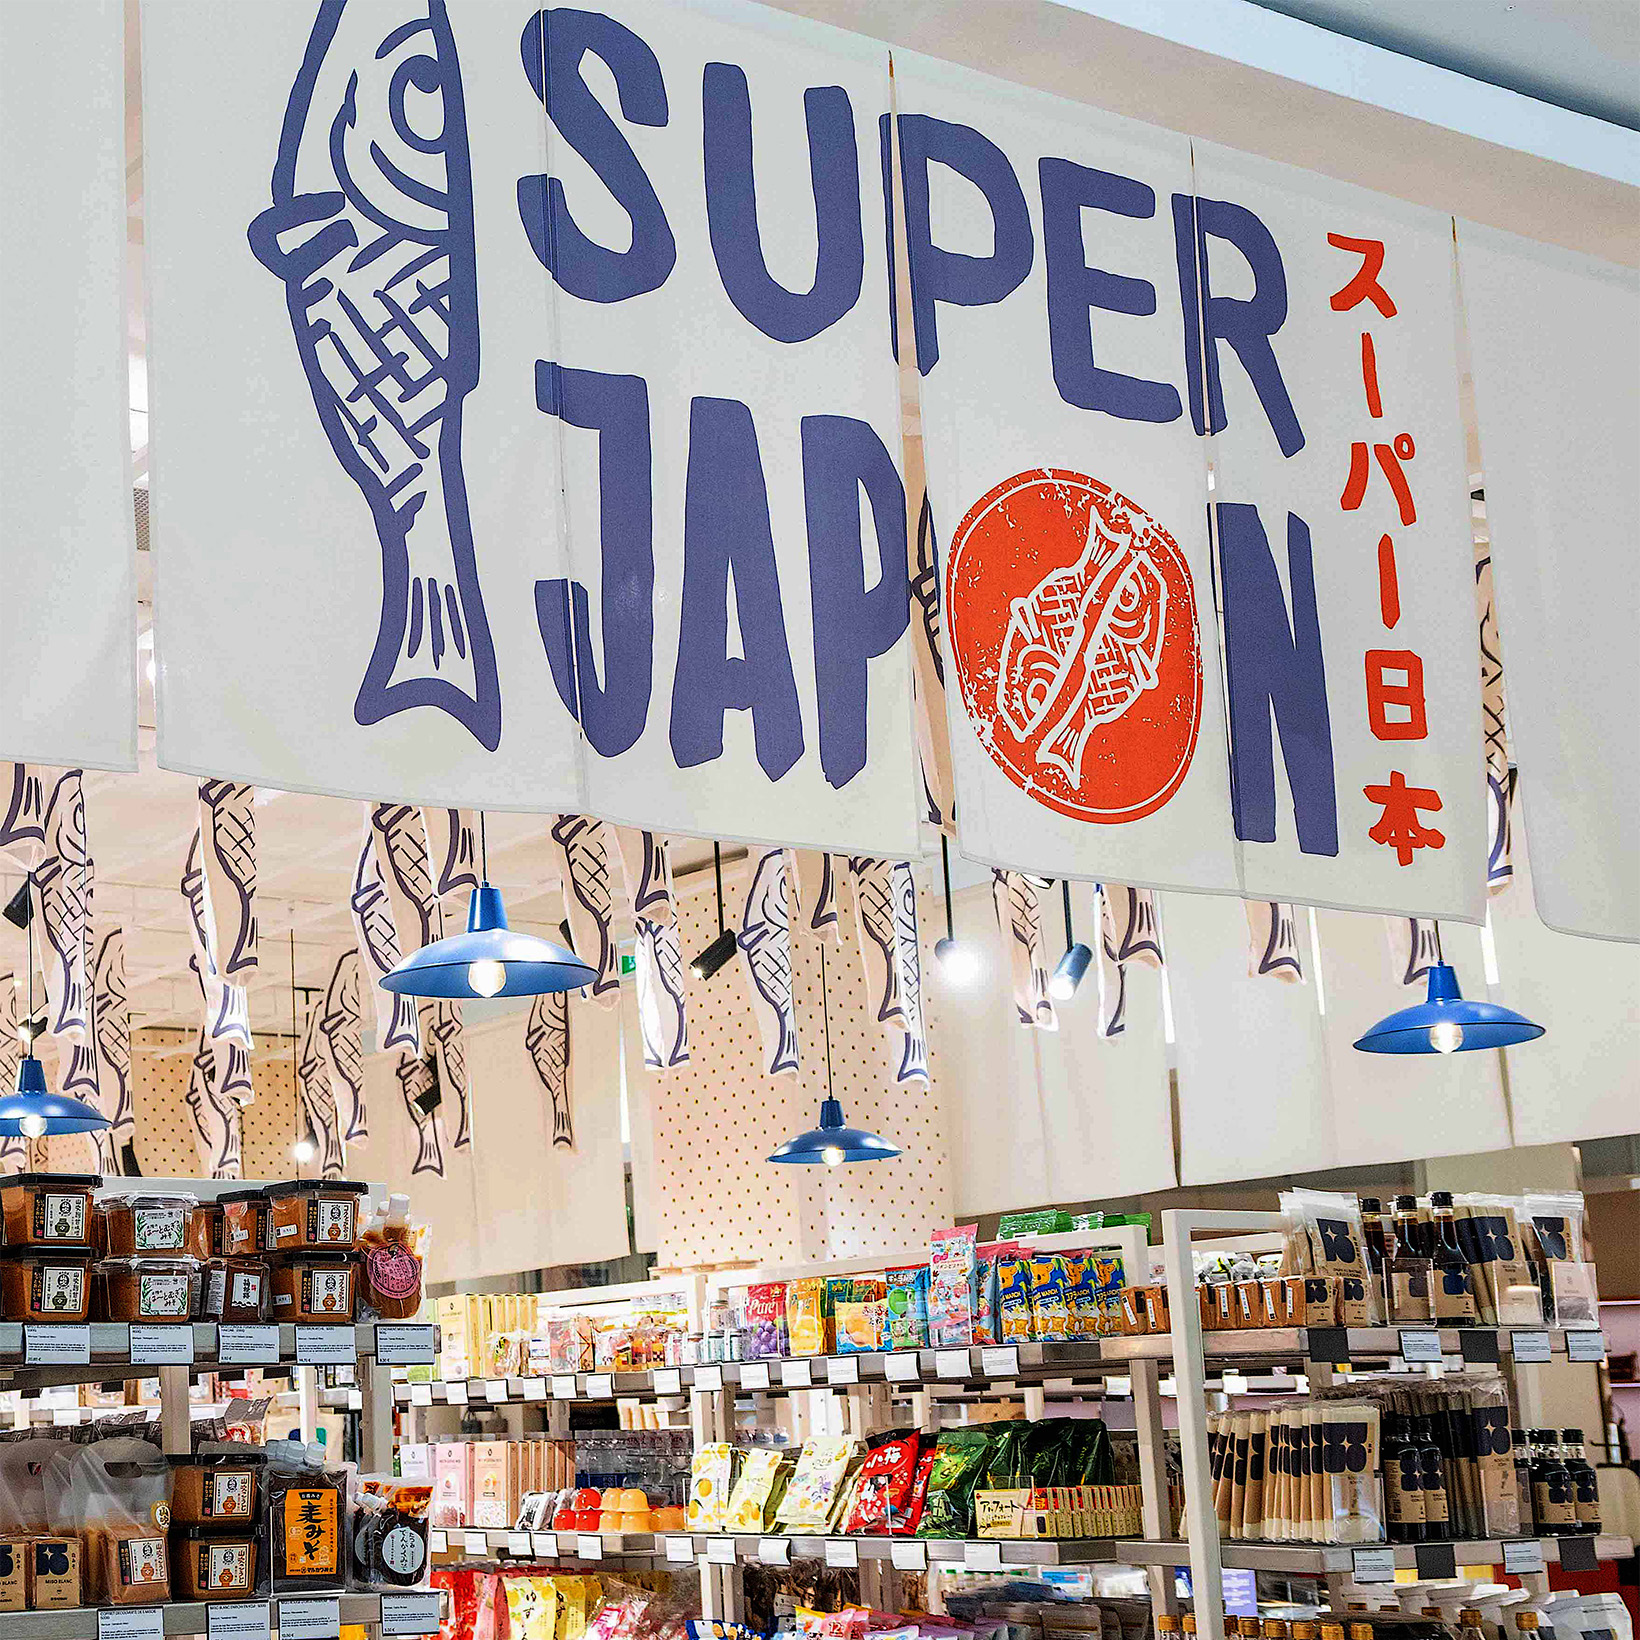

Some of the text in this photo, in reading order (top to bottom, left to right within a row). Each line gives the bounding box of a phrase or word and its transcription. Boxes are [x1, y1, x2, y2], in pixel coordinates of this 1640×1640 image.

[517, 8, 1306, 459] SUPER
[1327, 232, 1446, 868] スーパー日本
[295, 1500, 328, 1561] 麦みそ
[865, 1446, 902, 1469] 小梅
